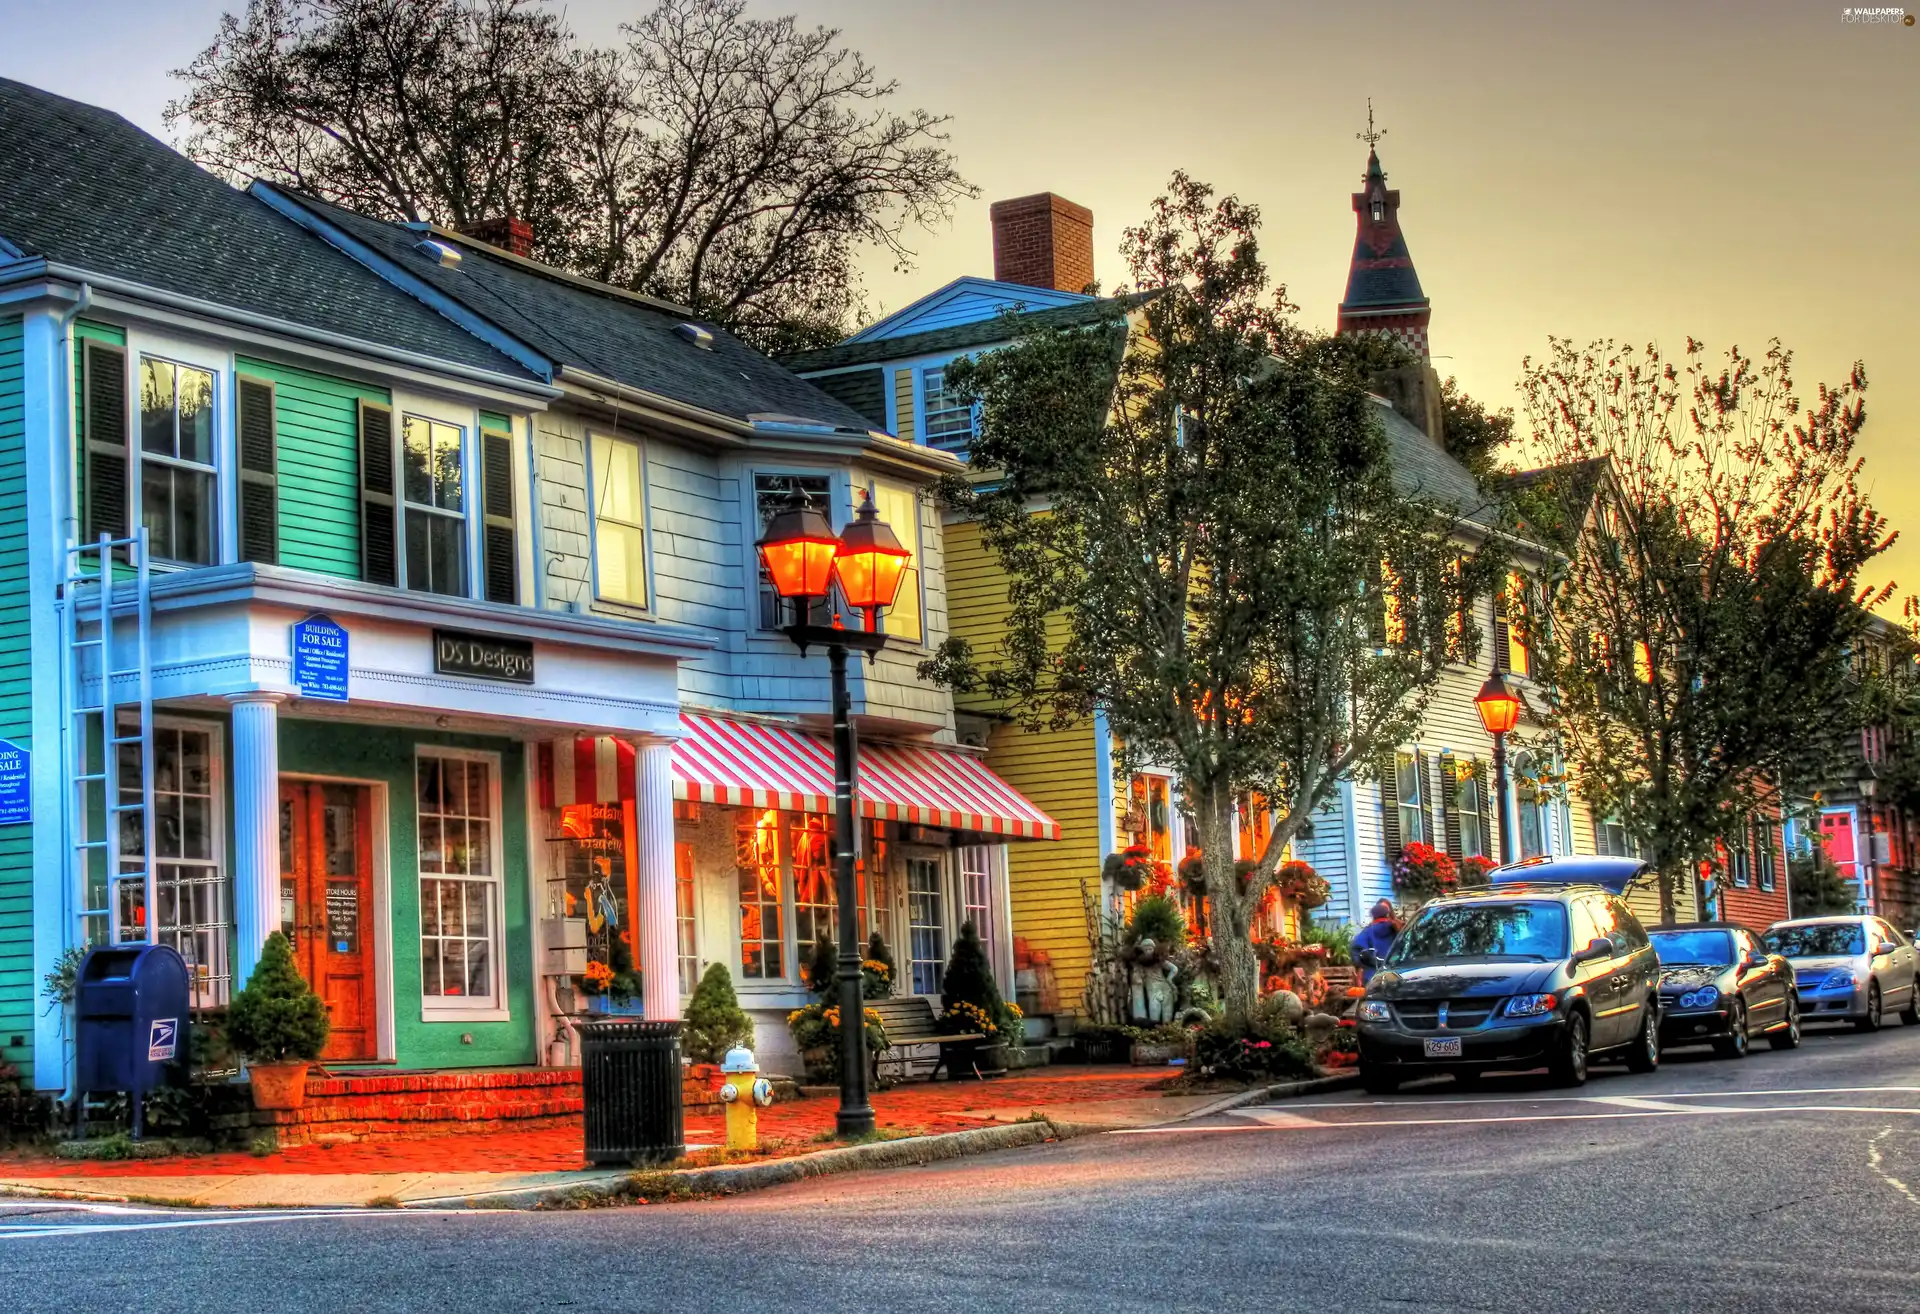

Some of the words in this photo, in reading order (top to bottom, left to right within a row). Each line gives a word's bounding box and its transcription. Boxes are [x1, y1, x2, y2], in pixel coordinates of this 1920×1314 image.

[305, 624, 339, 635] BUILDING
[302, 633, 319, 644] FOR
[321, 636, 341, 647] SALE
[441, 640, 464, 664] DS
[470, 643, 532, 676] Designs
[0, 760, 21, 770] SALE
[3, 772, 25, 780] Residential
